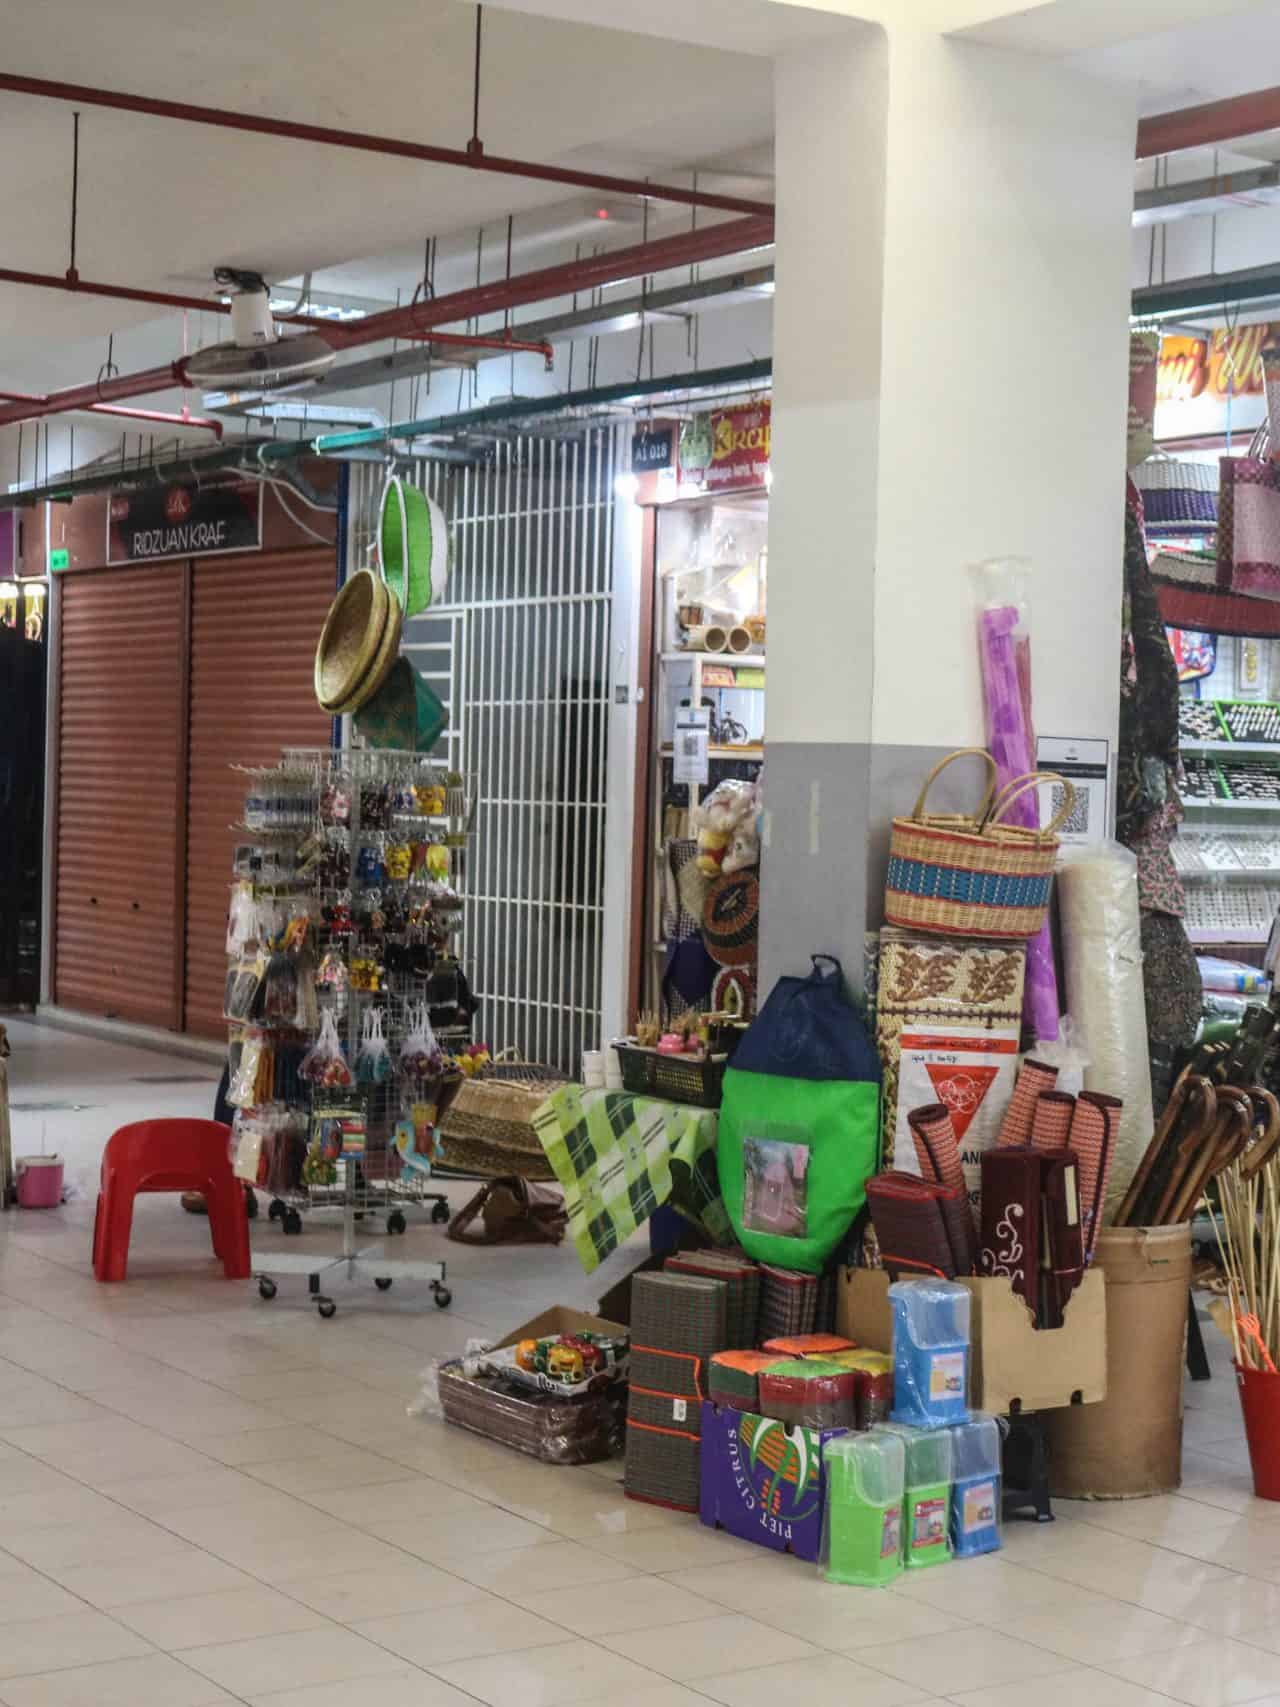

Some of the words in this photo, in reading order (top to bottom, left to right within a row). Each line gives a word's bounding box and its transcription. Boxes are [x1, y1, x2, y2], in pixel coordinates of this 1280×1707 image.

[133, 525, 189, 556] RIDZUAN
[189, 520, 227, 548] KRAF
[728, 1428, 755, 1510] CITRUS
[760, 1511, 792, 1539] PIET
